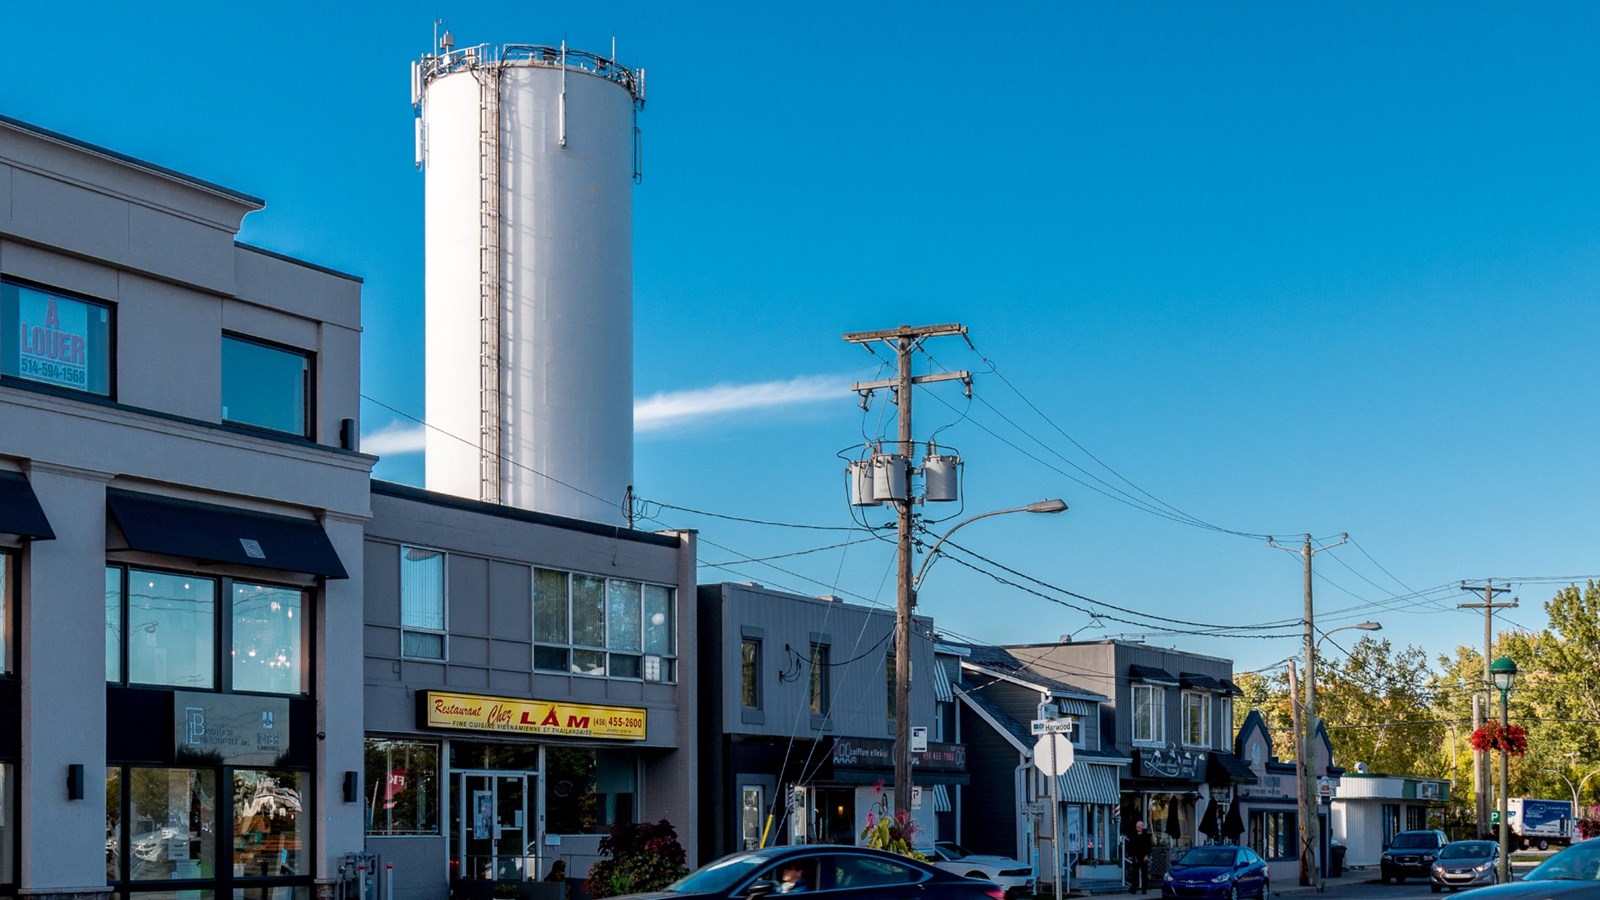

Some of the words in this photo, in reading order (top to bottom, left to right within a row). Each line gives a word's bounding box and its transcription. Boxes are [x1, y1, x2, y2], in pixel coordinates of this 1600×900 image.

[21, 323, 85, 365] LOUER
[22, 358, 85, 383] 514-594-1568
[434, 699, 482, 717] Restaurant
[487, 704, 513, 724] Chez
[608, 716, 643, 728] 455-2600
[469, 721, 495, 729] CUISINE
[497, 725, 541, 733] VIETNAMIENNE
[1045, 723, 1071, 731] Harwood
[1491, 812, 1499, 822] P
